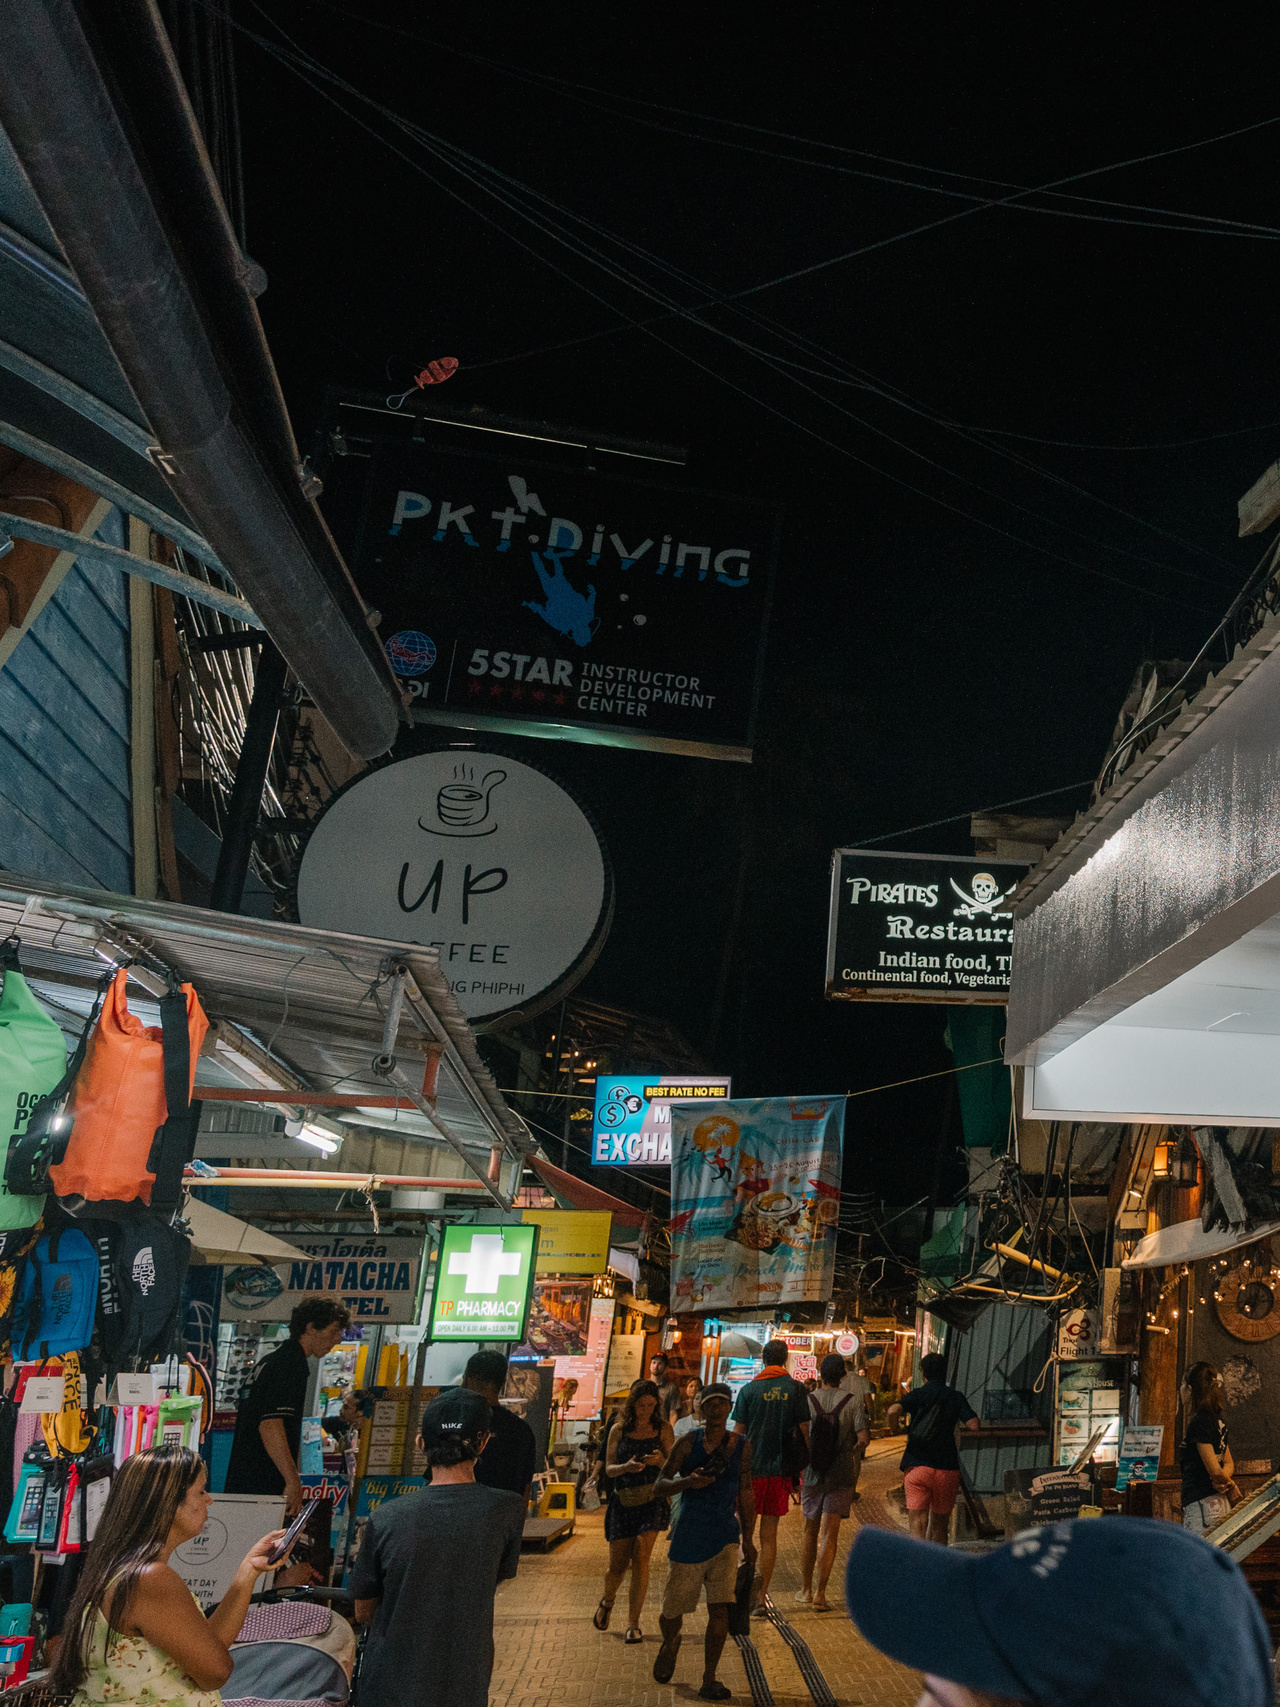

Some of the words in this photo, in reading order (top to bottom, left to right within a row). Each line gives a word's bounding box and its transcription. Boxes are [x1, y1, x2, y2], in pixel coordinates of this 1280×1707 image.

[467, 648, 574, 688] 5STAR
[583, 662, 701, 692] INSTRUCTOR
[579, 680, 716, 710] DEVELOPMENT
[577, 695, 649, 718] CENTER
[878, 951, 941, 969] Indian
[945, 953, 992, 972] food,
[842, 969, 917, 984] Continental
[920, 971, 952, 985] food,
[471, 981, 525, 995] PHIPHI
[646, 1087, 669, 1097] BEST
[670, 1087, 693, 1097] RATE
[694, 1087, 708, 1097] NO
[709, 1087, 725, 1097] FEE
[131, 1264, 141, 1282] THE
[140, 1263, 149, 1296] NORTH
[147, 1262, 156, 1287] FACE
[288, 1261, 411, 1290] NATACHA
[440, 1301, 454, 1316] TP
[456, 1301, 521, 1317] PHARMACY
[1060, 1346, 1088, 1357] Flight
[793, 1370, 817, 1381] Roti
[365, 1480, 389, 1498] Big
[1033, 1508, 1050, 1516] Pasta
[200, 1580, 218, 1588] DAY
